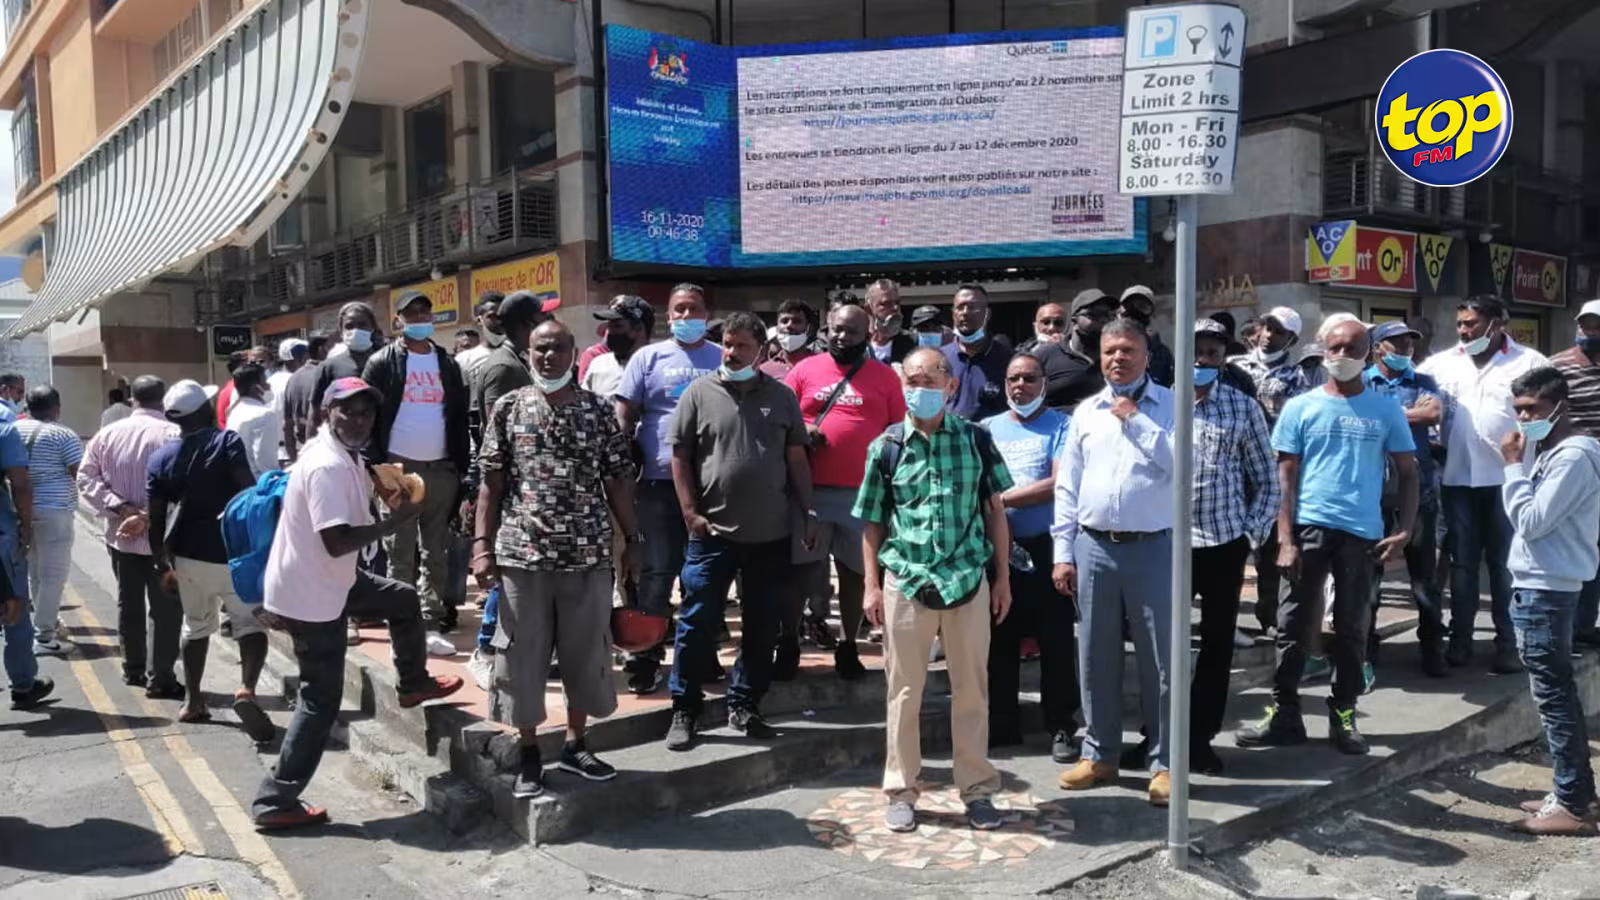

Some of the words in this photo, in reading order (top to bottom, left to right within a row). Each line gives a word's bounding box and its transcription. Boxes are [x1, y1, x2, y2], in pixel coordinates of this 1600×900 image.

[1006, 43, 1051, 58] Québec
[746, 90, 764, 100] Les
[766, 88, 827, 99] inscriptions
[829, 88, 841, 97] se
[843, 86, 865, 96] font
[866, 84, 934, 95] uniquement
[936, 82, 951, 91] en
[953, 81, 981, 91] ligne
[981, 77, 1029, 90] jusqu'au
[1031, 76, 1045, 86] 22
[1047, 74, 1105, 85] novembre
[1143, 72, 1196, 89] Zone
[1205, 69, 1214, 83] 1
[744, 106, 756, 115] le
[756, 105, 777, 115] site
[778, 104, 792, 113] du
[794, 101, 846, 113] ministère
[847, 101, 862, 110] de
[864, 98, 937, 110] l'immigration
[938, 96, 954, 106] du
[955, 93, 998, 106] Québec
[1131, 94, 1175, 110] Limit
[1181, 91, 1193, 106] 2
[1199, 90, 1230, 106] hrs
[1132, 120, 1173, 136] Mon
[1195, 116, 1225, 132] Fri
[745, 151, 763, 161] Les
[765, 149, 818, 160] entrevues
[820, 149, 832, 158] se
[834, 146, 887, 157] tiendront
[887, 146, 902, 154] en
[904, 144, 931, 155] ligne
[933, 143, 947, 152] du
[958, 142, 972, 150] au
[975, 140, 988, 150] 12
[990, 138, 1047, 149] décembre
[1049, 136, 1078, 147] 2020
[1127, 138, 1161, 152] 8.00
[1178, 135, 1227, 149] 16.30
[1130, 152, 1219, 169] Saturday
[746, 181, 764, 191] Les
[765, 178, 801, 190] détails
[802, 179, 821, 189] des
[823, 178, 858, 189] postes
[860, 175, 921, 187] disponibles
[922, 174, 946, 183] sont
[948, 173, 975, 183] aussi
[977, 168, 1017, 182] publiés
[1018, 170, 1035, 179] sur
[1038, 168, 1069, 178] notre
[1071, 167, 1091, 177] site
[1126, 174, 1158, 189] 8.00
[1175, 172, 1223, 186] 12.30
[641, 210, 705, 229] 16-11-2020
[647, 225, 699, 241] 09:46:38
[516, 270, 528, 290] de
